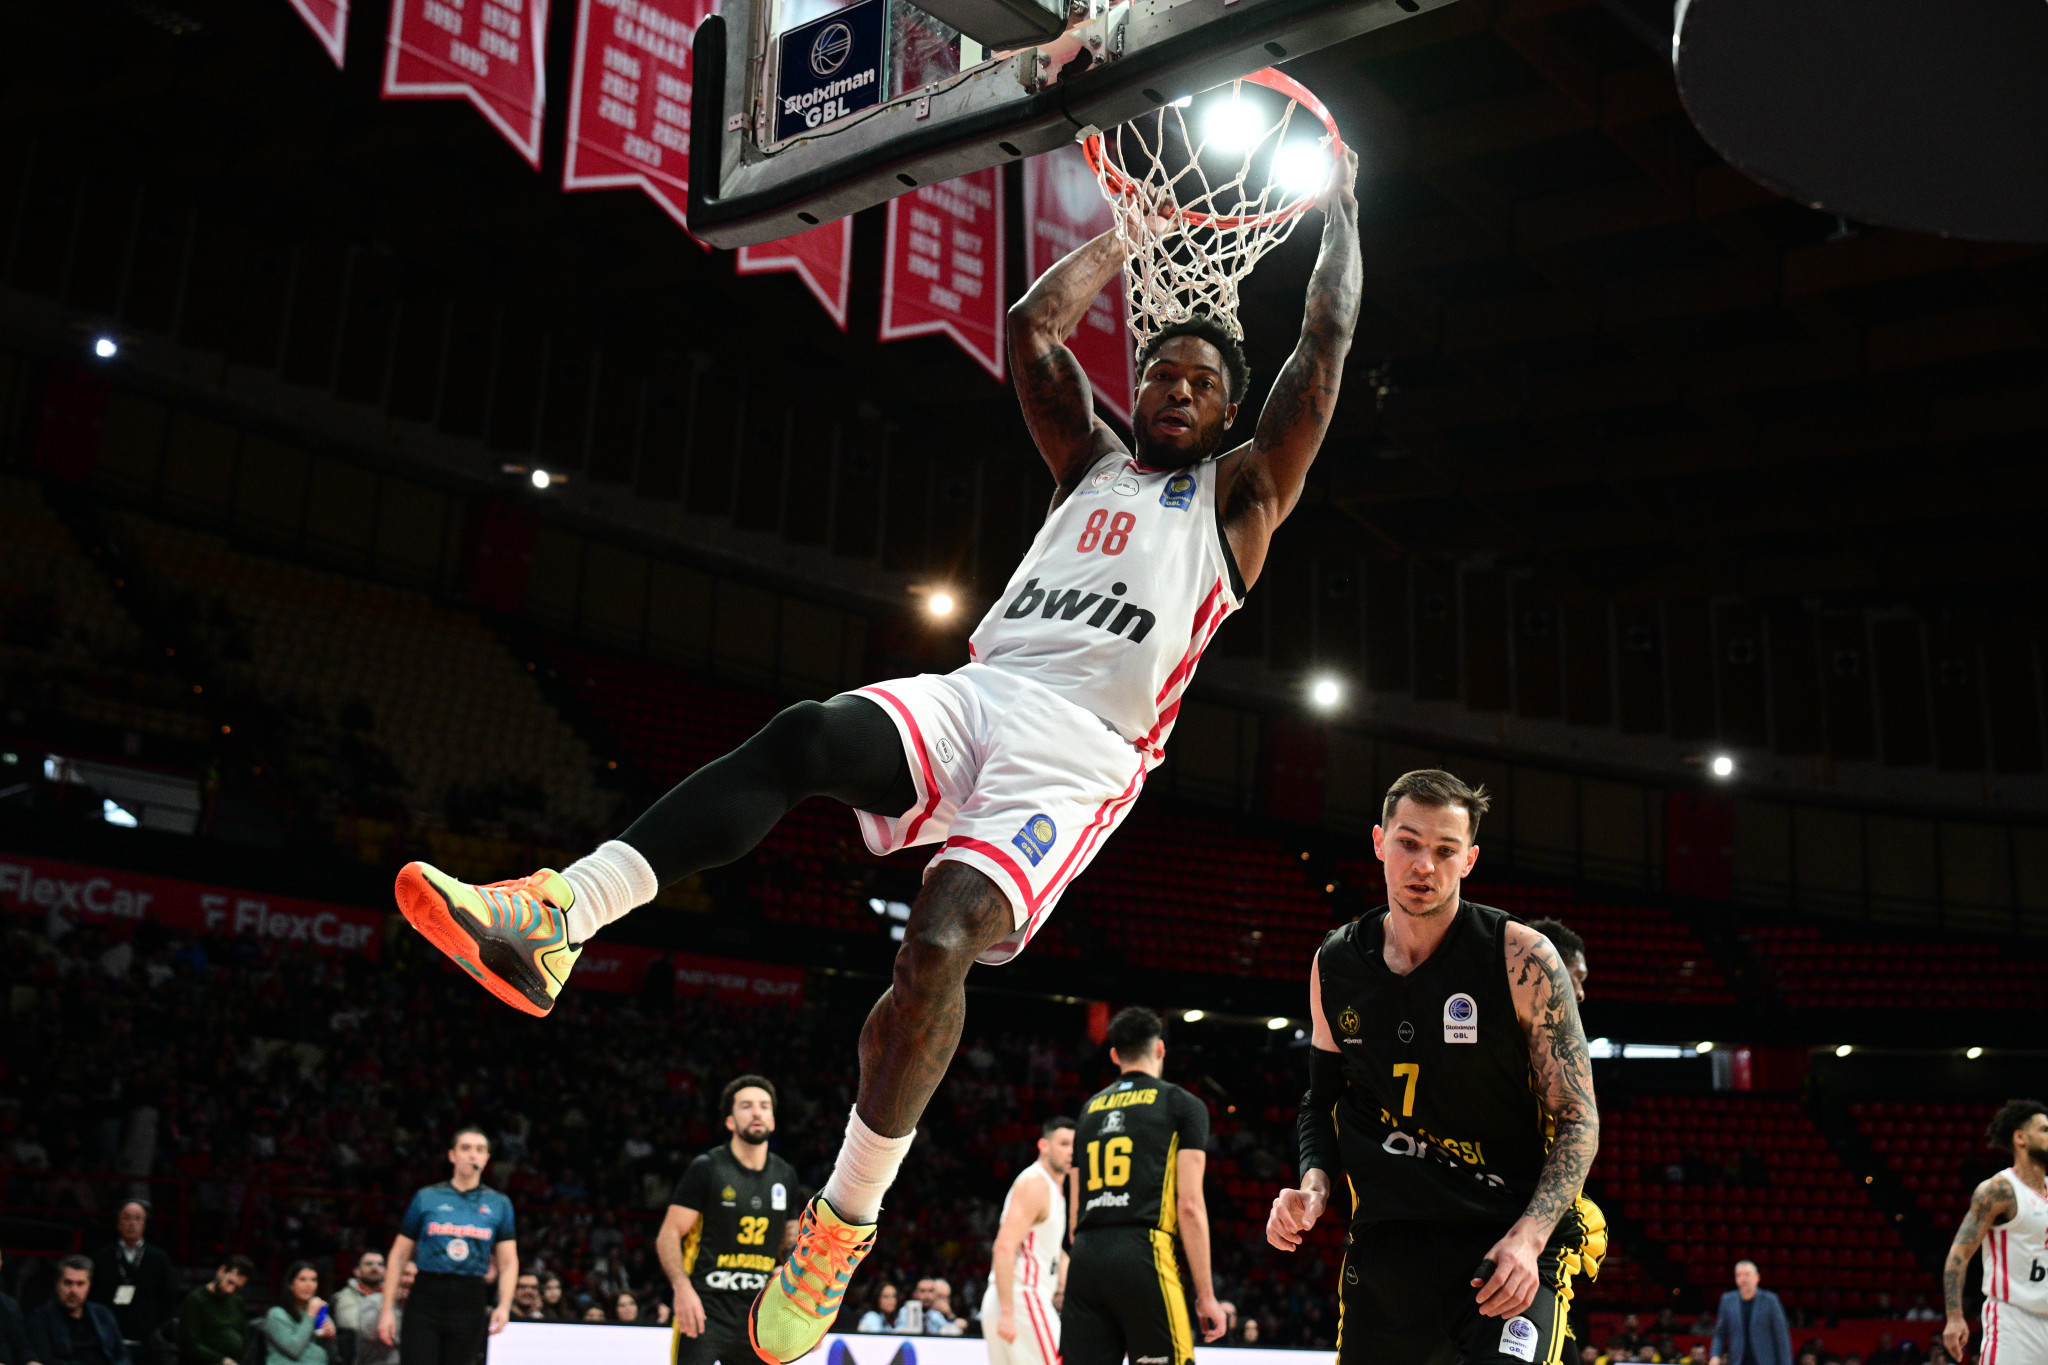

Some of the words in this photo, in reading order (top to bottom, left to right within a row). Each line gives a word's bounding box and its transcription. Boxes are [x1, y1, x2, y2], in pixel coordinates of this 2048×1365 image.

[784, 68, 875, 115] Stoiximan
[805, 97, 850, 129] GBL
[1076, 508, 1137, 556] 88
[1003, 577, 1156, 645] bwin
[233, 898, 376, 950] FlexCar
[1392, 1062, 1420, 1118] 7
[1086, 1135, 1134, 1192] 16
[736, 1215, 770, 1246] 32
